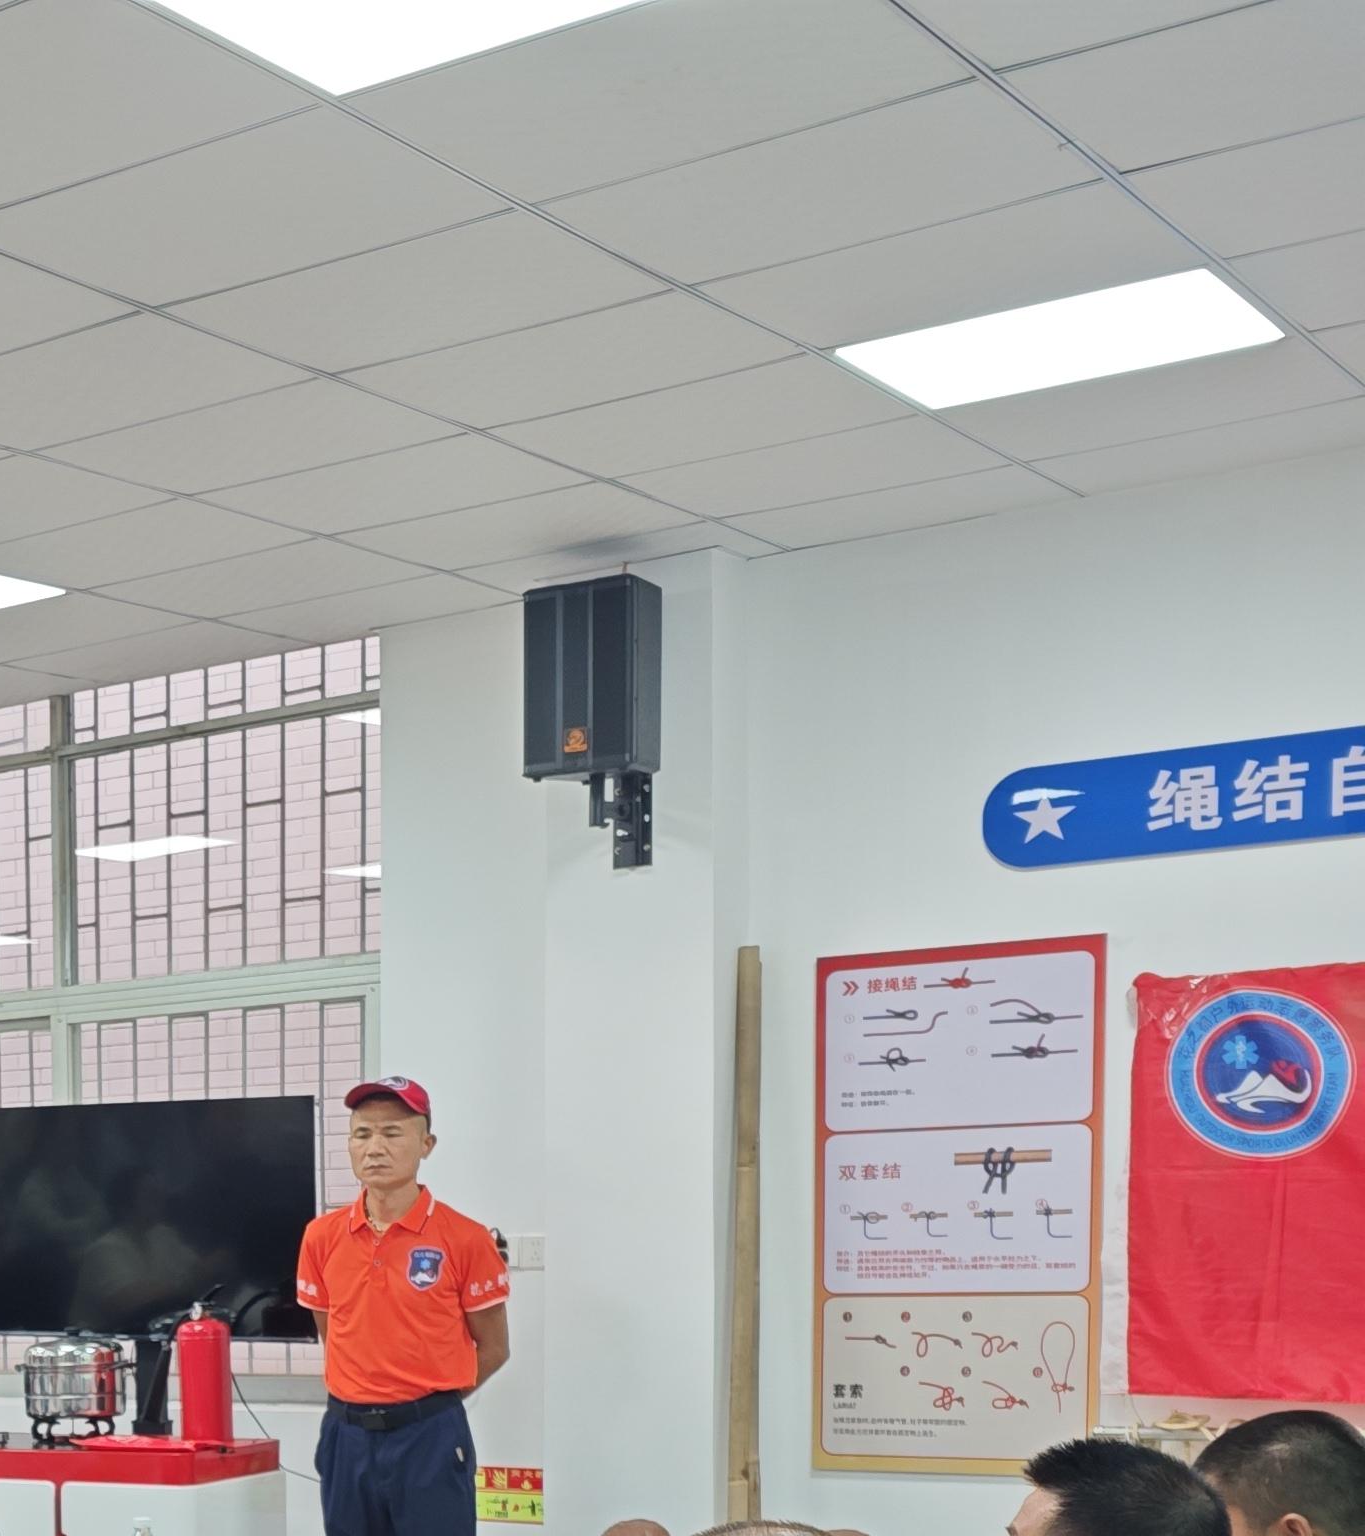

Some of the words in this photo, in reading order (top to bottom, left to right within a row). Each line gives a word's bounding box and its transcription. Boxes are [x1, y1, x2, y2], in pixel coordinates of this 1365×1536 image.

[866, 975, 918, 995] 接绳结
[838, 1163, 902, 1181] 双套结
[833, 1383, 864, 1399] 套索
